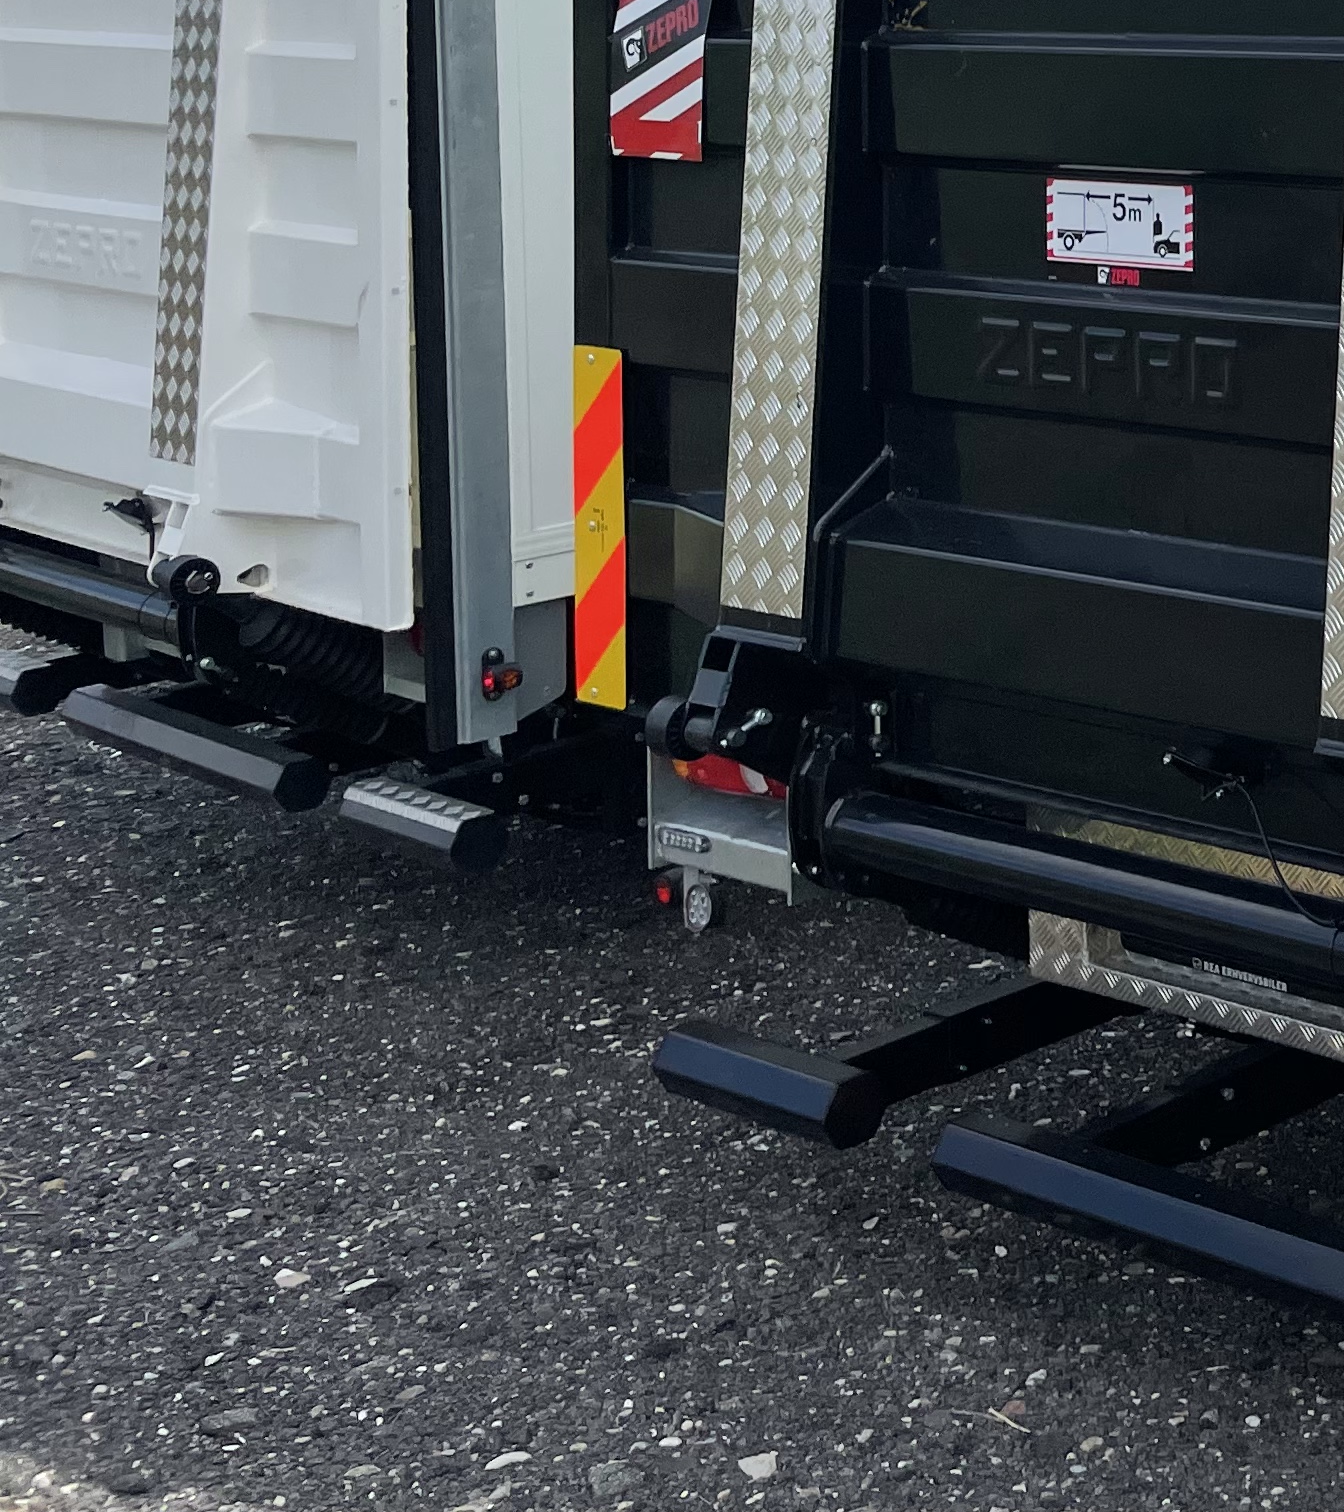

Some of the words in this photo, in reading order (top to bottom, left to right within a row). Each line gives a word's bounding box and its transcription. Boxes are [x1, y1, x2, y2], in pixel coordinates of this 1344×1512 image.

[1111, 268, 1140, 287] ZEPRO
[977, 317, 1238, 402] ZEPRO
[1203, 961, 1220, 974] REA
